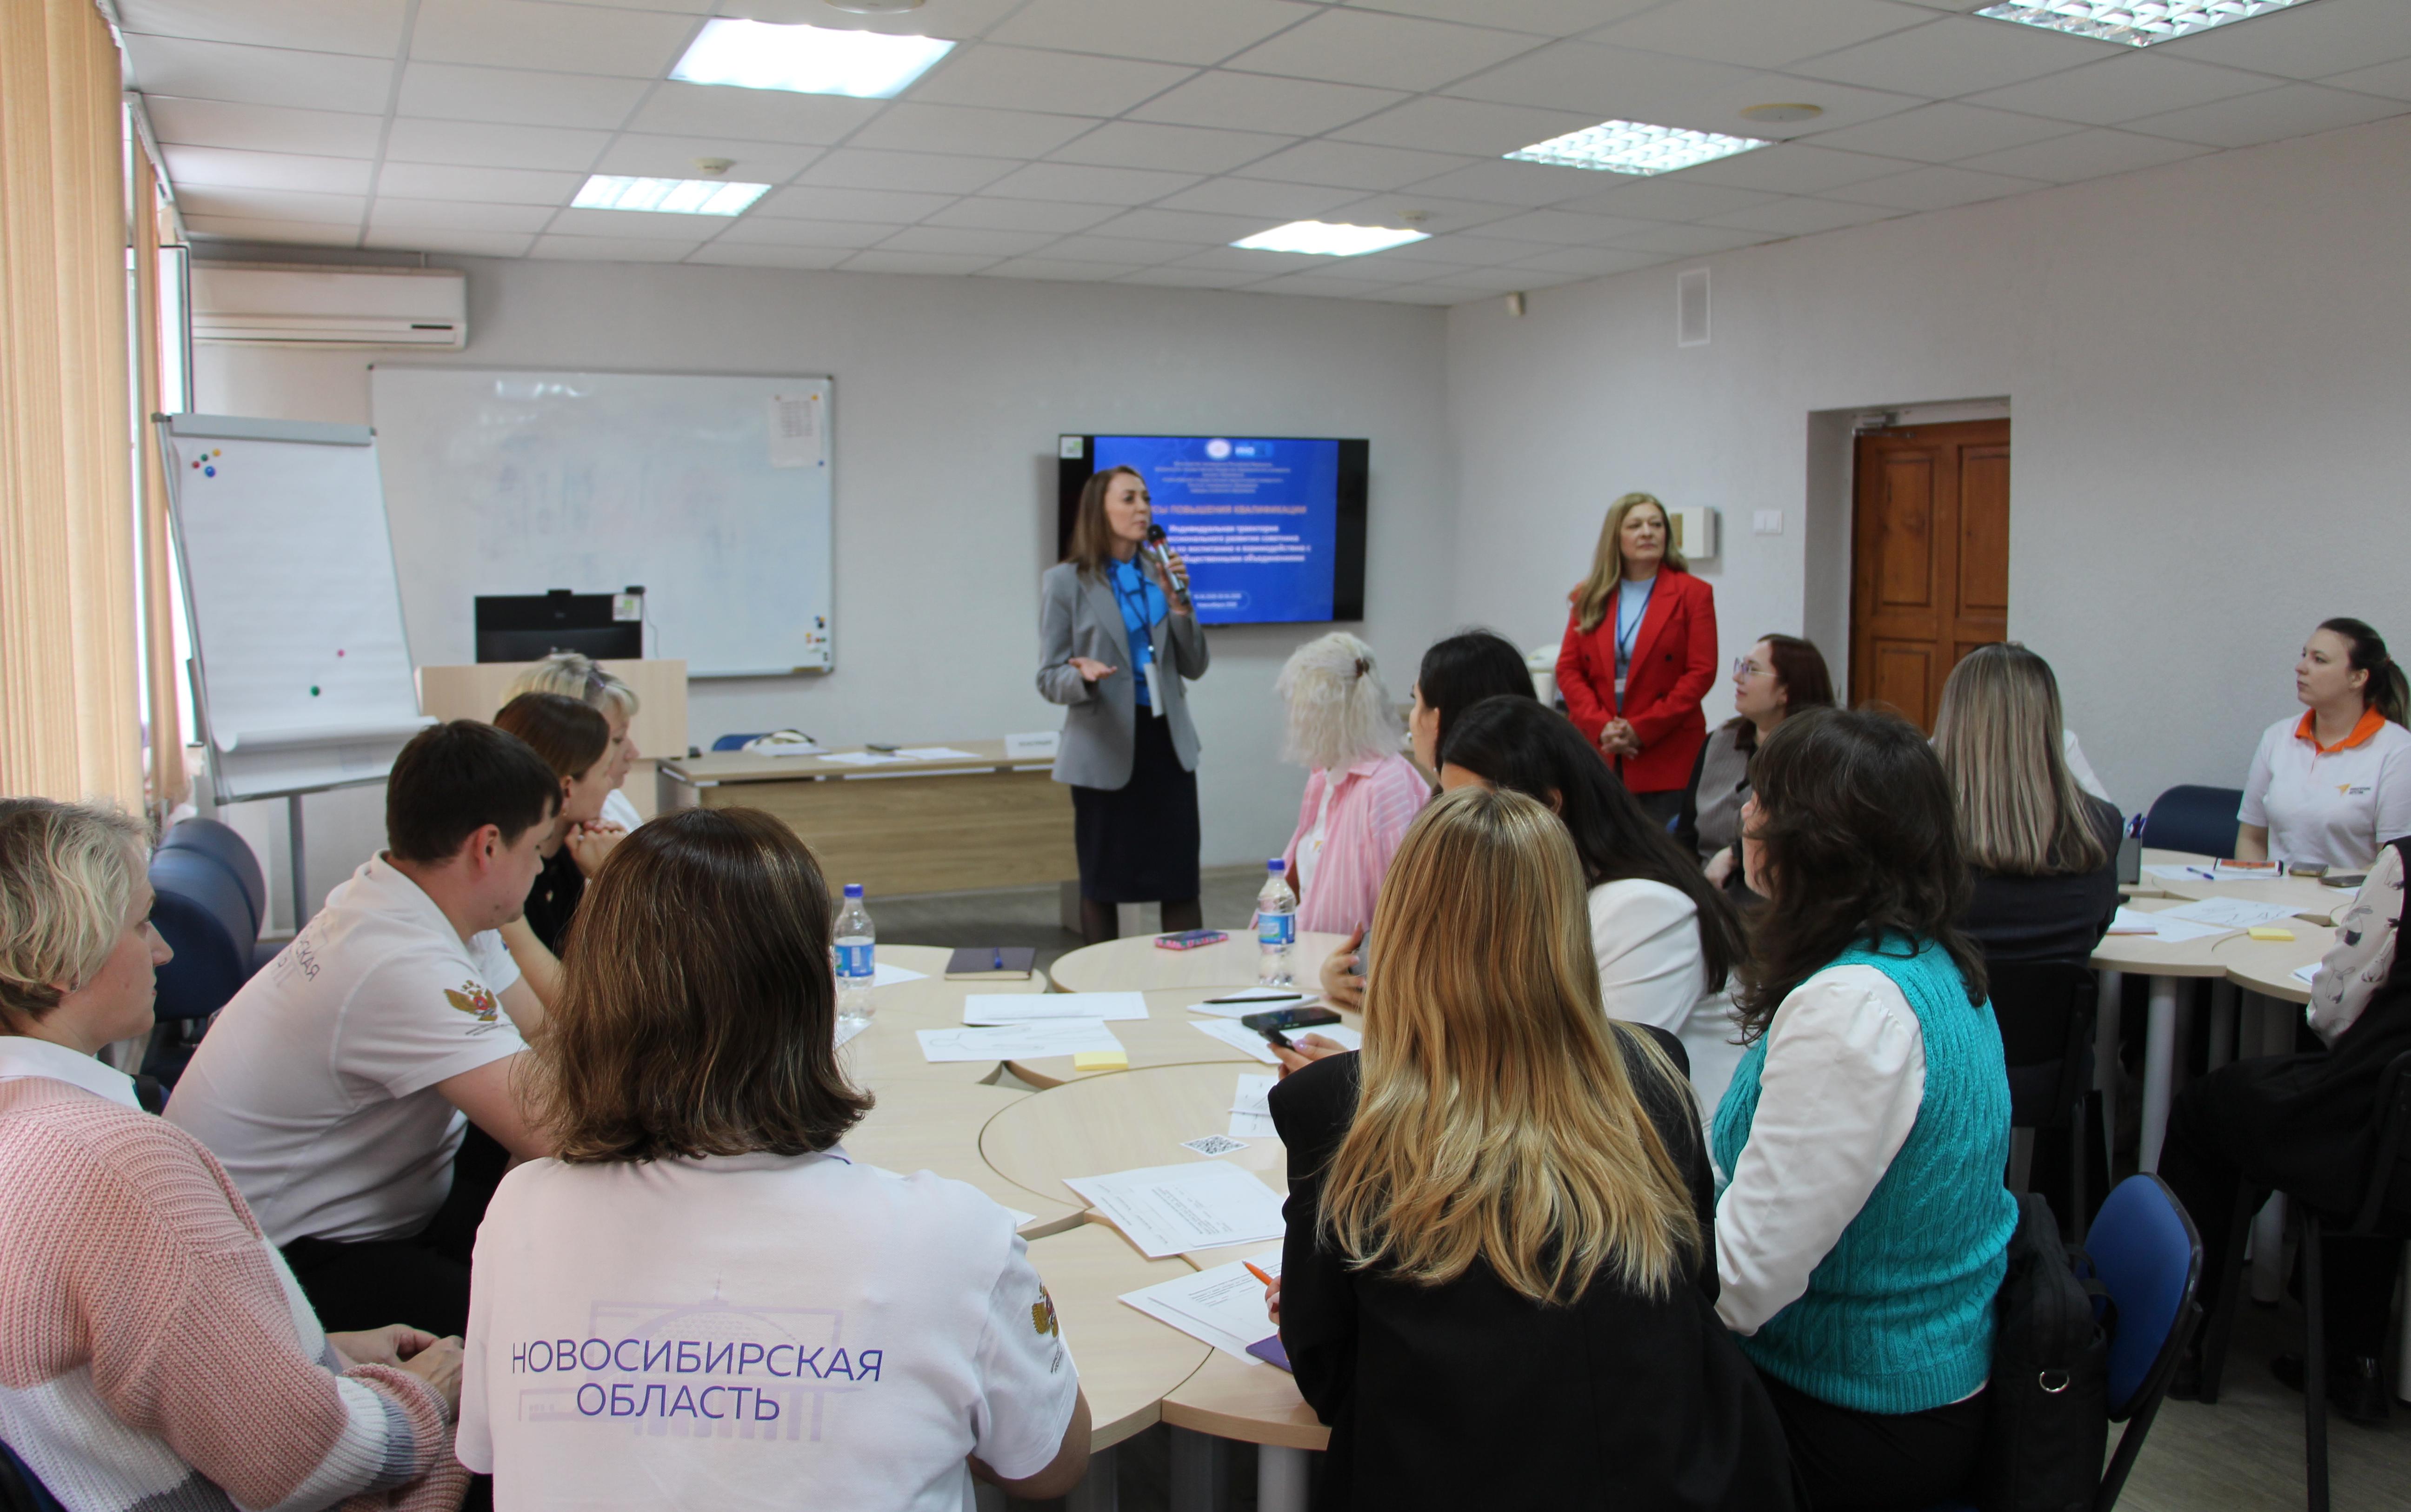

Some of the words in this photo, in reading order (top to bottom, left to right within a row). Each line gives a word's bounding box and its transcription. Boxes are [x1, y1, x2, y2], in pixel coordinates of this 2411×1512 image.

[1170, 505, 1232, 514] ПОВЫШЕНИЯ
[513, 1338, 883, 1382] НОВОСИБИРСКАЯ
[577, 1383, 780, 1421] ОБЛАСТЬ
